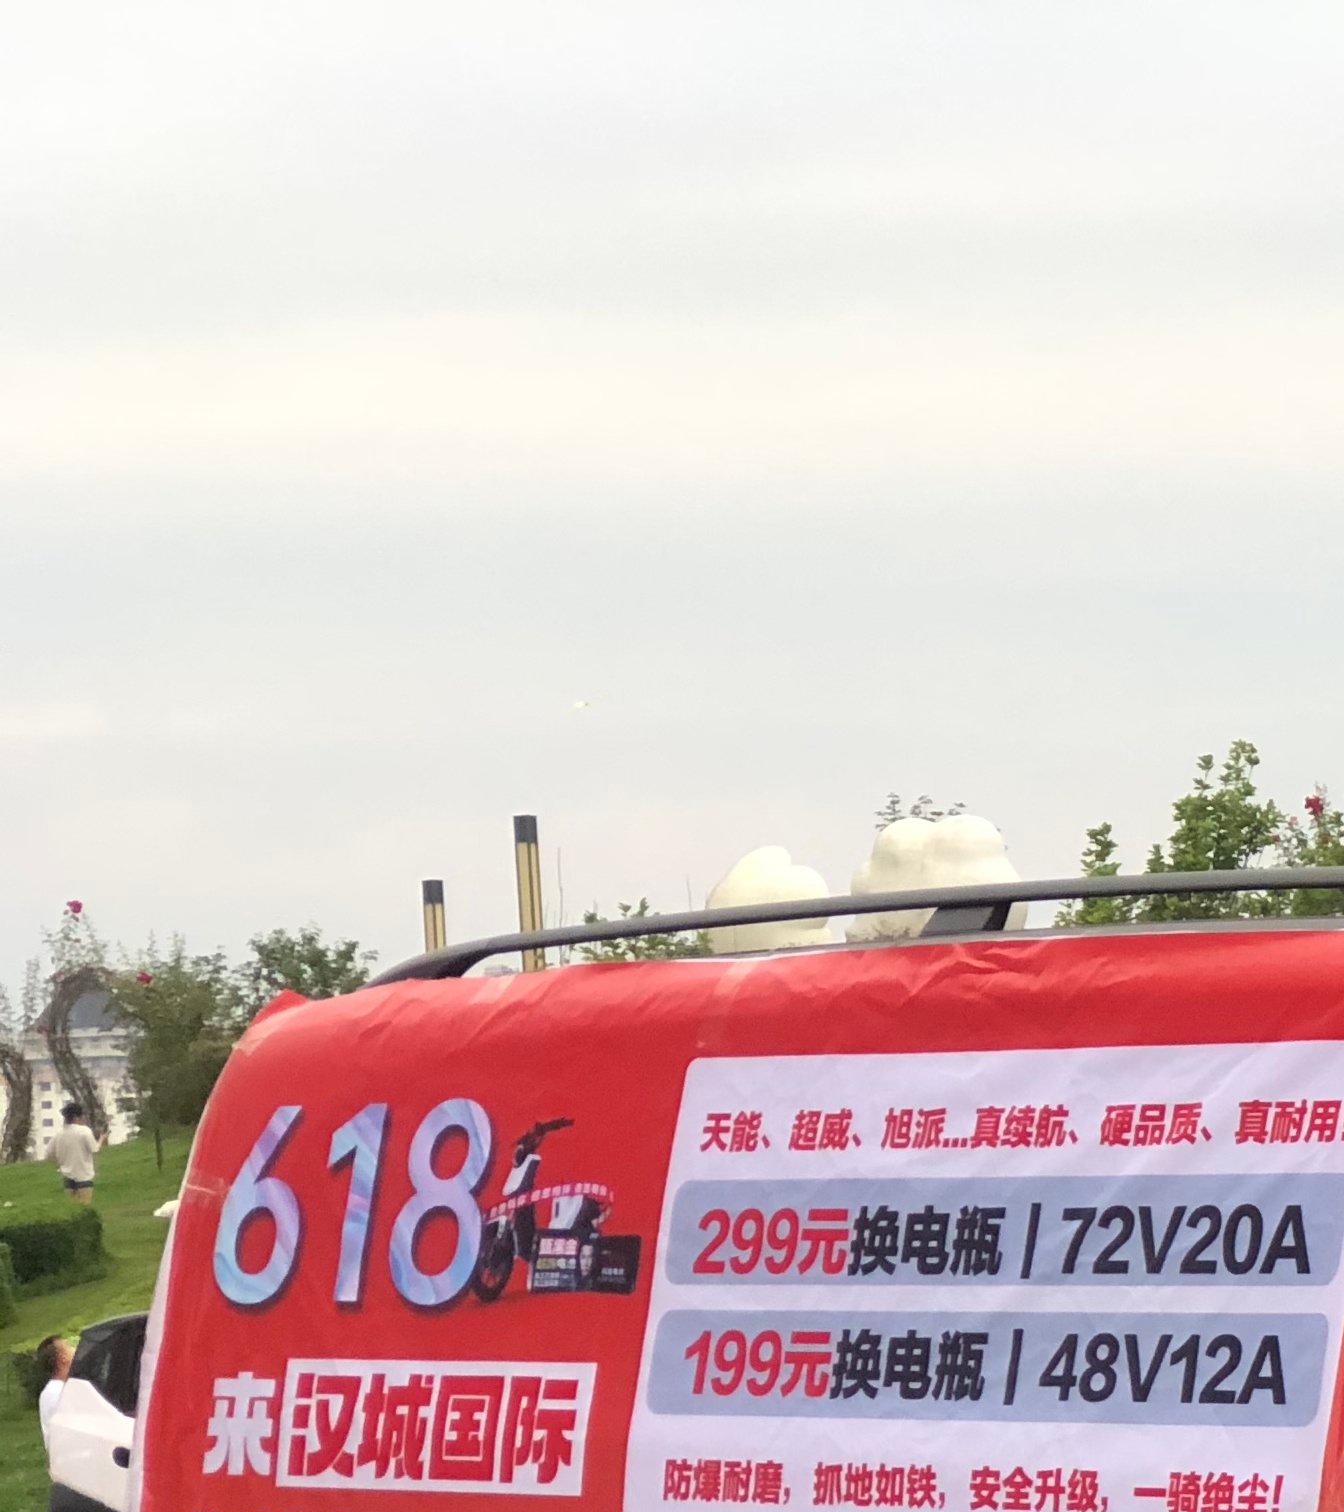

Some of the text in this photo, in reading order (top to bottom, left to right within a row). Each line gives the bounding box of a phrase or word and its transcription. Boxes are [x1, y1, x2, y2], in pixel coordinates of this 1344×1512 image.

[212, 1097, 492, 1307] 618
[692, 1205, 1005, 1276] 299元换电瓶
[1061, 1205, 1311, 1275] 72V20A
[684, 1329, 989, 1401] 199元换电瓶
[1039, 1333, 1287, 1405] 48V12A
